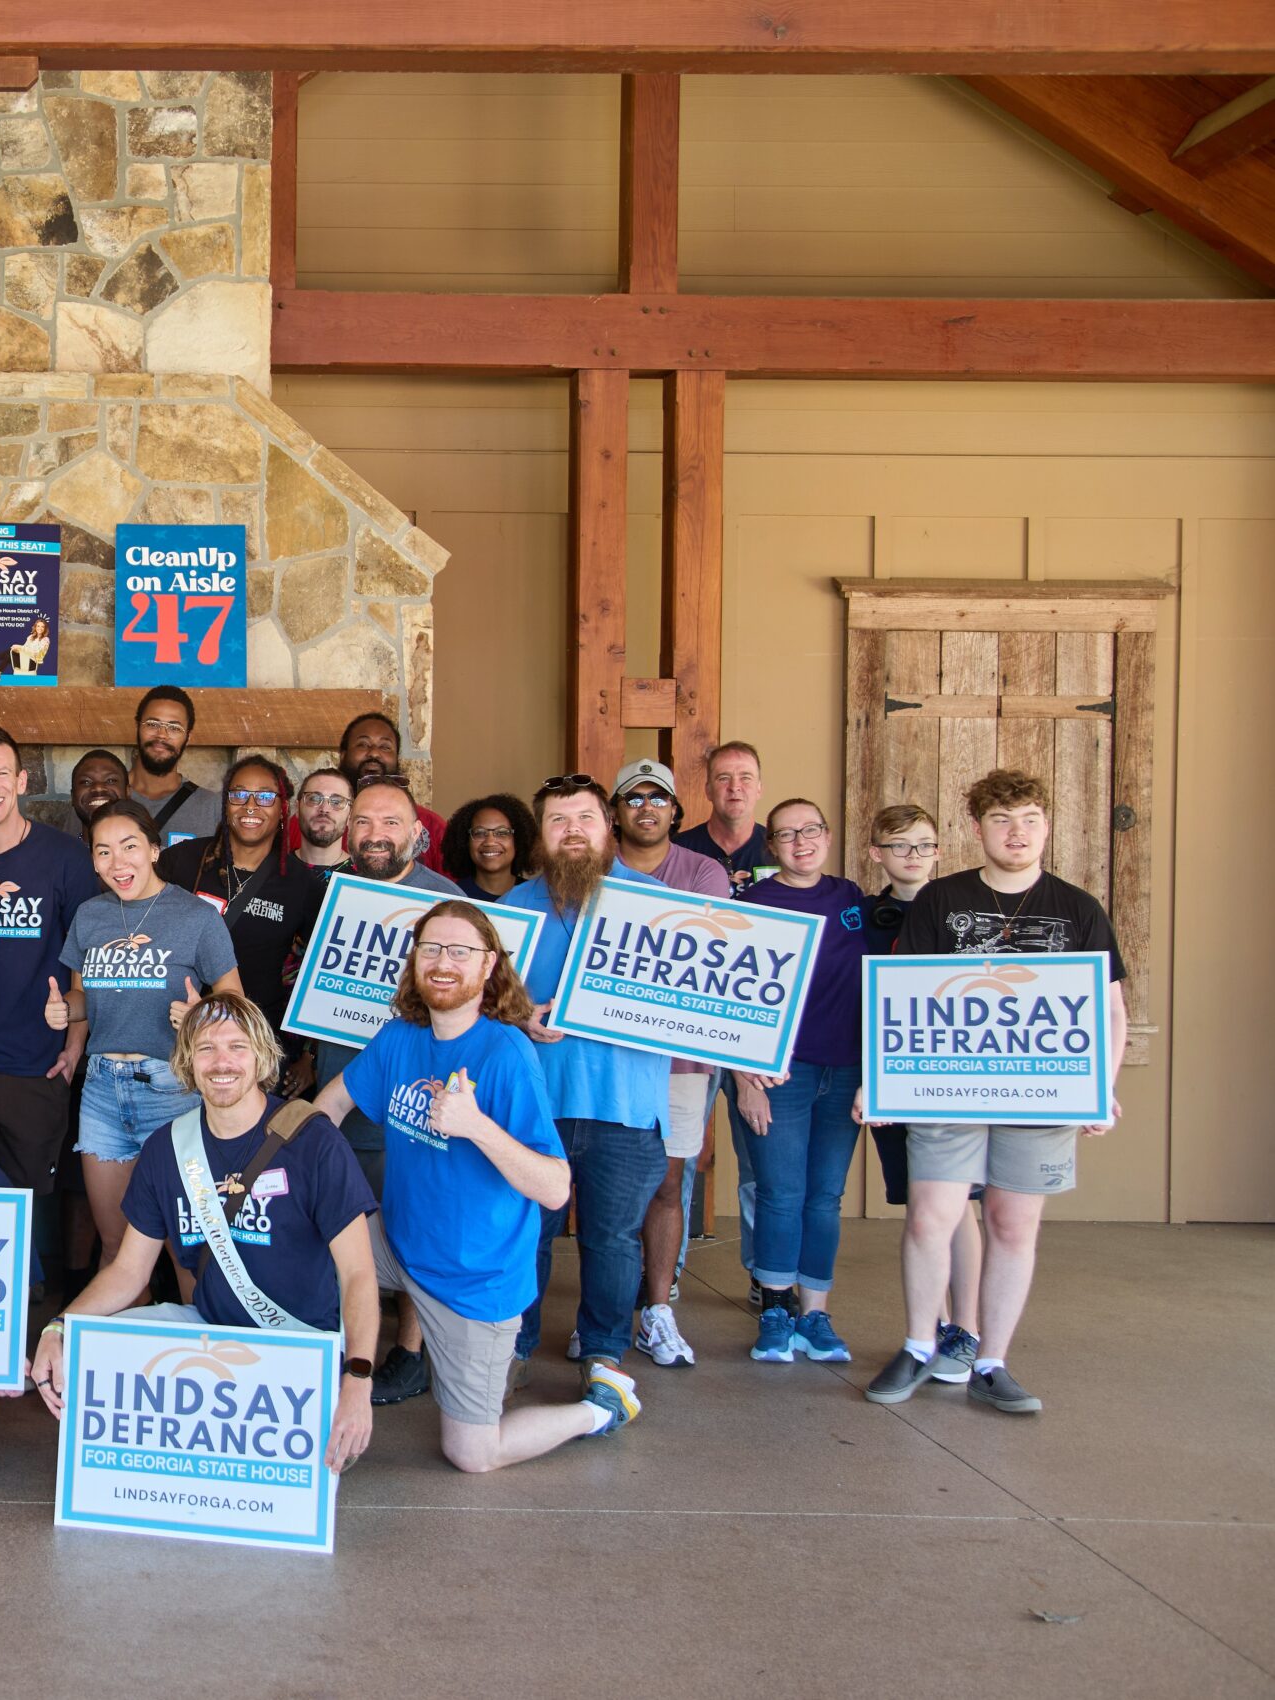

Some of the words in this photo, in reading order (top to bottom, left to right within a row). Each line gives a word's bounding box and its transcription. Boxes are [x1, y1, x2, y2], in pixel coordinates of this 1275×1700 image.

[21, 542, 46, 551] SEAT!
[126, 546, 236, 571] CleanUp
[126, 576, 161, 591] on
[168, 570, 236, 592] Aisle
[84, 948, 172, 965] LINDSAY
[592, 916, 796, 980] LINDSAY
[82, 964, 168, 978] DEFRANCO
[321, 946, 400, 985] DEFR
[585, 946, 786, 1006] DEFRANCO
[139, 980, 165, 988] HOUSE
[318, 976, 344, 991] FOR
[583, 976, 612, 990] FOR
[615, 981, 678, 1005] GEORGIA
[681, 996, 723, 1014] STATE
[726, 1005, 777, 1024] HOUSE
[883, 996, 1090, 1027] LINDSAY
[603, 1007, 741, 1044] LINDSAYFORGA.COM
[883, 1028, 1091, 1054] DEFRANCO
[886, 1059, 915, 1071] FOR
[918, 1059, 985, 1072] GEORGIA
[988, 1059, 1032, 1072] STATE
[1035, 1060, 1088, 1072] HOUSE
[914, 1087, 1058, 1098] LINDSAYFORGA.COM
[394, 1121, 415, 1135] GEORGIA
[415, 1131, 429, 1142] STATE
[429, 1138, 448, 1151] HOUSE
[182, 1236, 198, 1244] FOR
[242, 1234, 269, 1243] HOUSE
[243, 1291, 286, 1327] 2026
[84, 1369, 316, 1426] LINDSAY
[82, 1410, 314, 1460] DEFRANCO
[85, 1449, 117, 1465] FOR
[121, 1452, 194, 1473] GEORGIA
[198, 1459, 247, 1478] STATE
[250, 1465, 309, 1483] HOUSE
[114, 1487, 274, 1513] LINDSAYFORGA.COM
